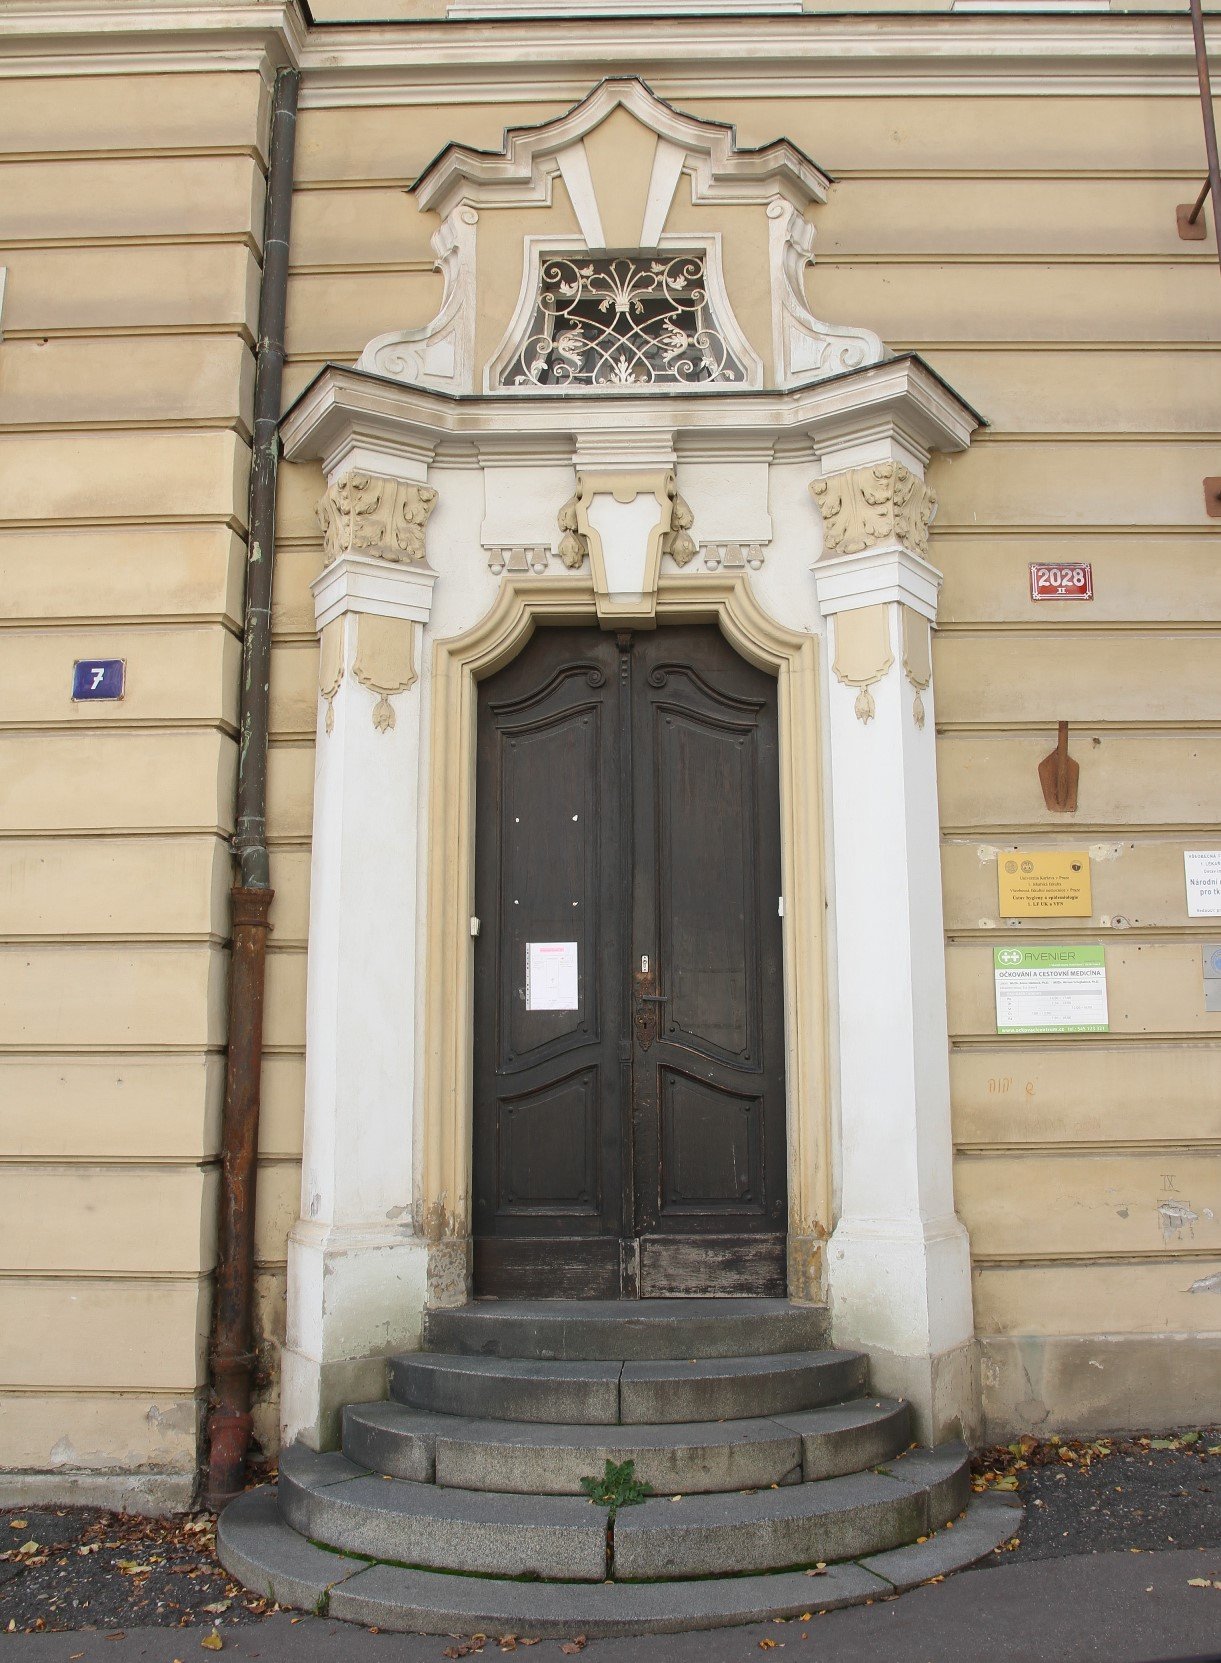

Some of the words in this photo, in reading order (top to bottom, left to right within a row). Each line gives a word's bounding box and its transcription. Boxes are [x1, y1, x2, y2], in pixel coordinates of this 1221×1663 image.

[1038, 569, 1084, 586] 2028
[90, 668, 104, 690] 7
[1190, 878, 1218, 886] Národní
[1200, 889, 1212, 897] pro
[1024, 952, 1076, 961] AVENIER
[999, 970, 1032, 978] OČKOVÁNÍ
[1070, 969, 1102, 977] MEDICÍNA
